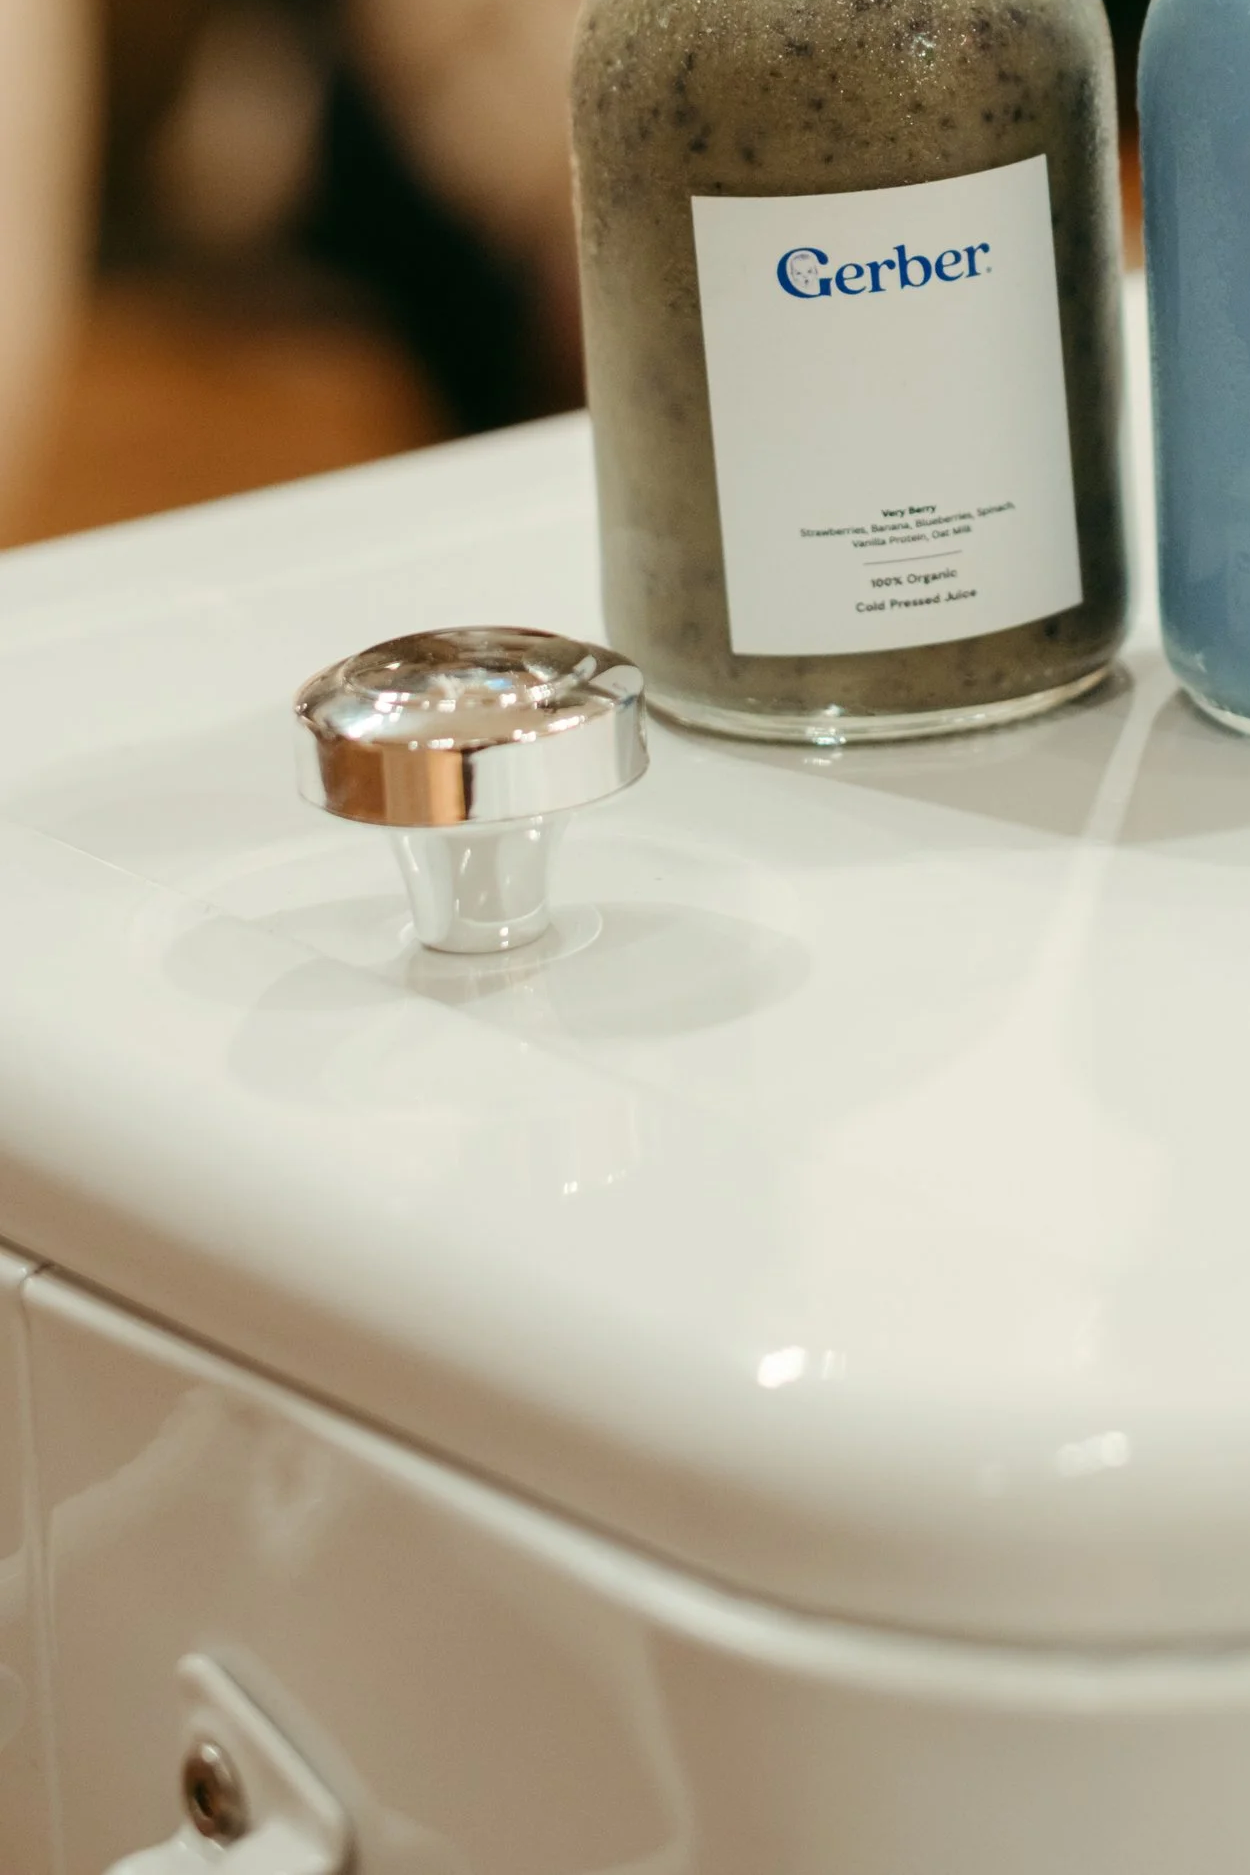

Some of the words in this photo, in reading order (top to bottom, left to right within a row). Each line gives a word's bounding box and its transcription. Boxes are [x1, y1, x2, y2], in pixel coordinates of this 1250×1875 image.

[776, 241, 991, 299] Gerber
[881, 509, 905, 518] Very
[909, 505, 937, 515] Berry
[852, 538, 886, 549] Vanilla
[932, 530, 949, 540] Oat
[871, 576, 903, 588] 100%
[907, 568, 957, 585] Organic
[856, 599, 885, 613] Cold
[890, 593, 941, 609] Pressed
[945, 588, 977, 602] Juice
